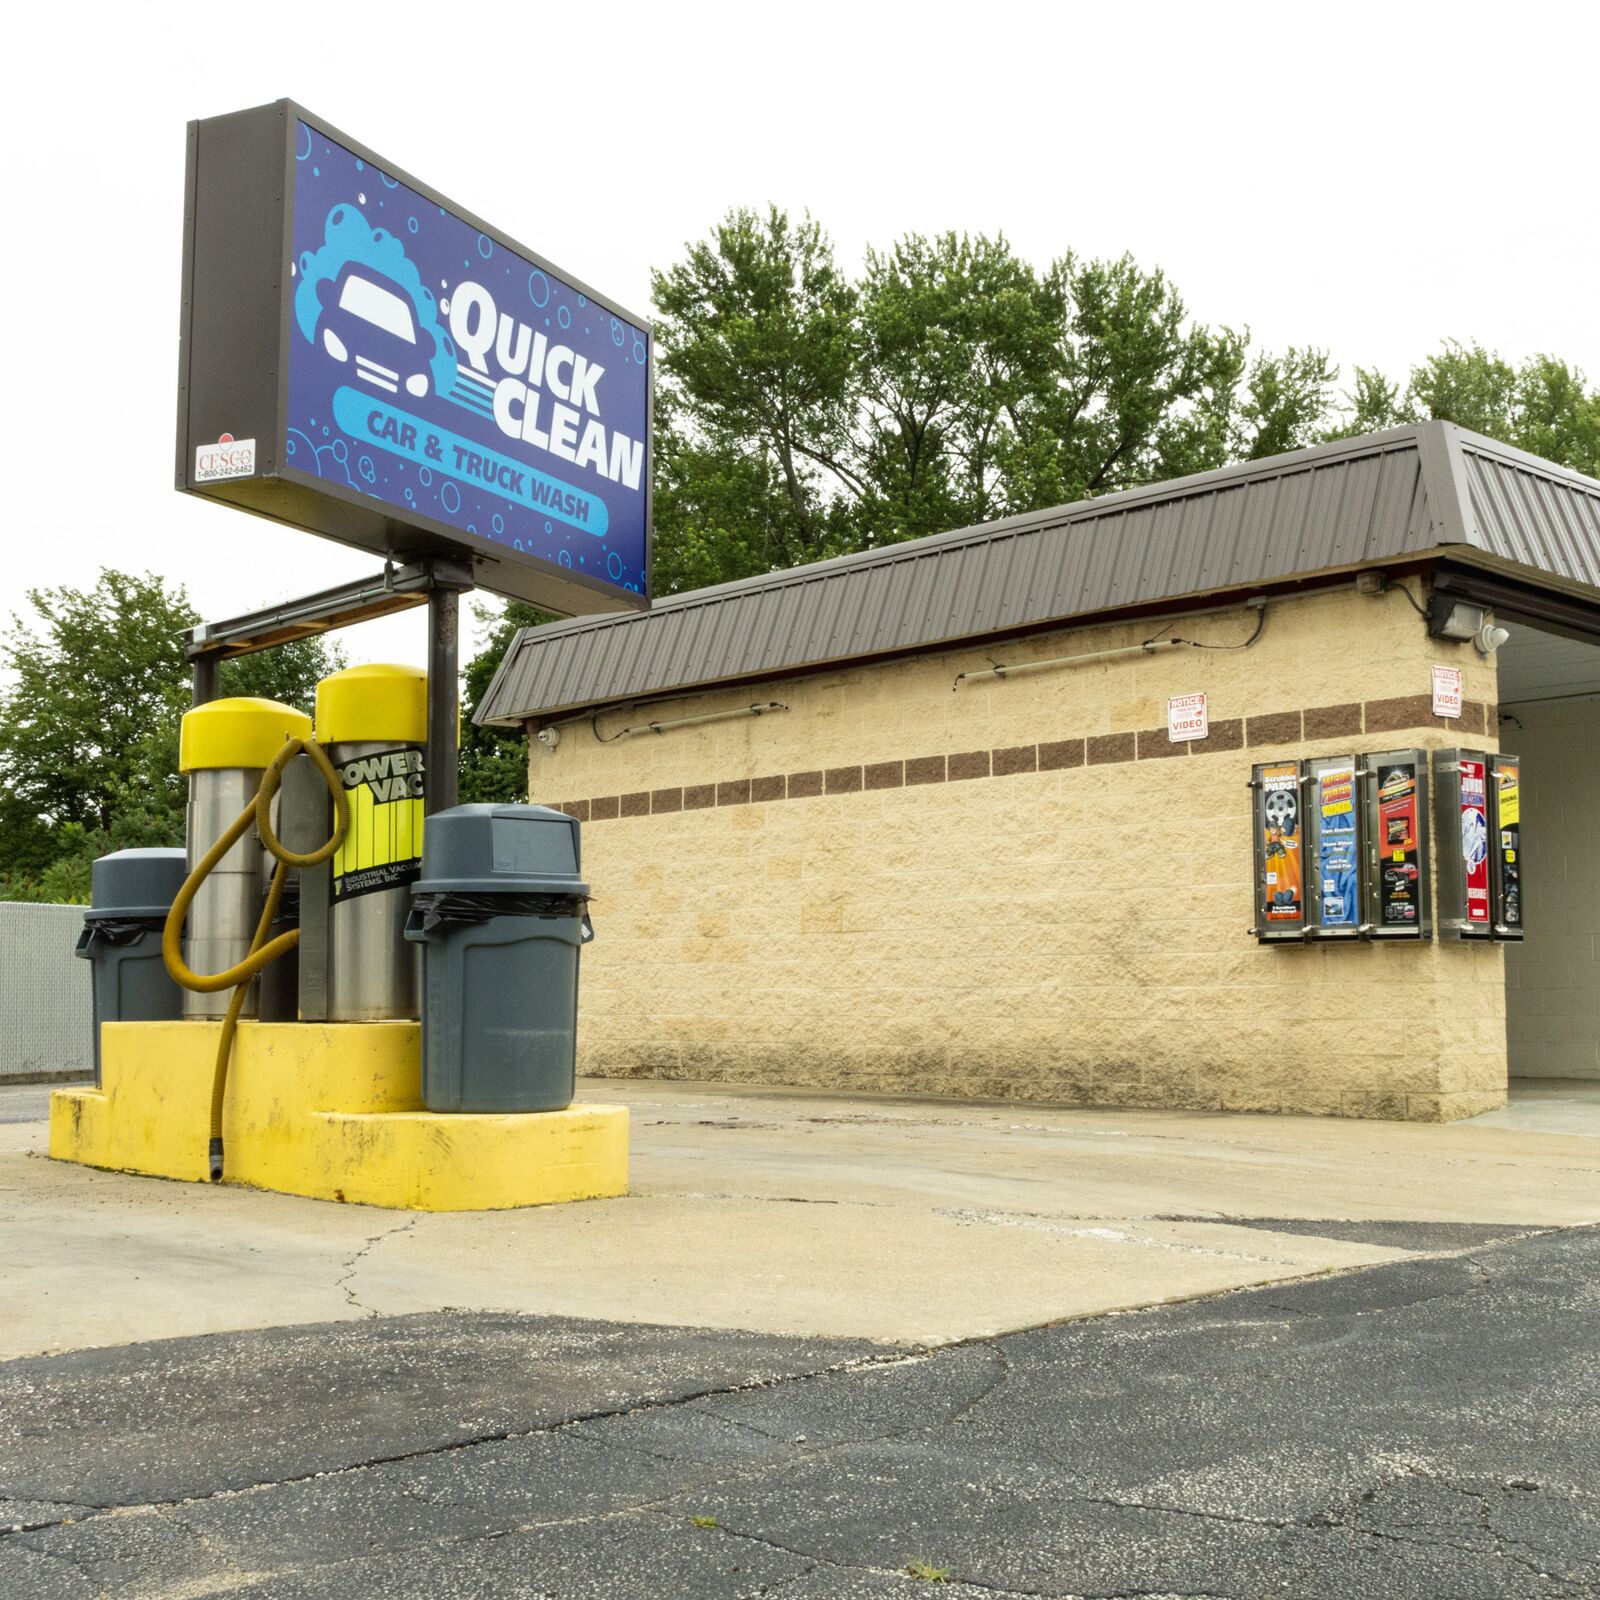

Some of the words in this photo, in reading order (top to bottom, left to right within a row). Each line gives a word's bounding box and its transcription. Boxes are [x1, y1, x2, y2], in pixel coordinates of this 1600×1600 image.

[449, 281, 605, 417] QUICK
[493, 377, 643, 491] CLEAN
[199, 448, 252, 471] CESCO
[367, 410, 417, 451] CAR
[424, 434, 443, 463] &
[453, 443, 525, 496] TRUCK
[531, 477, 589, 523] WASH
[1437, 693, 1459, 705] VIDEO
[1173, 719, 1202, 730] VIDEO
[369, 773, 424, 802] VAC
[345, 868, 388, 885] INDUSTRIAL
